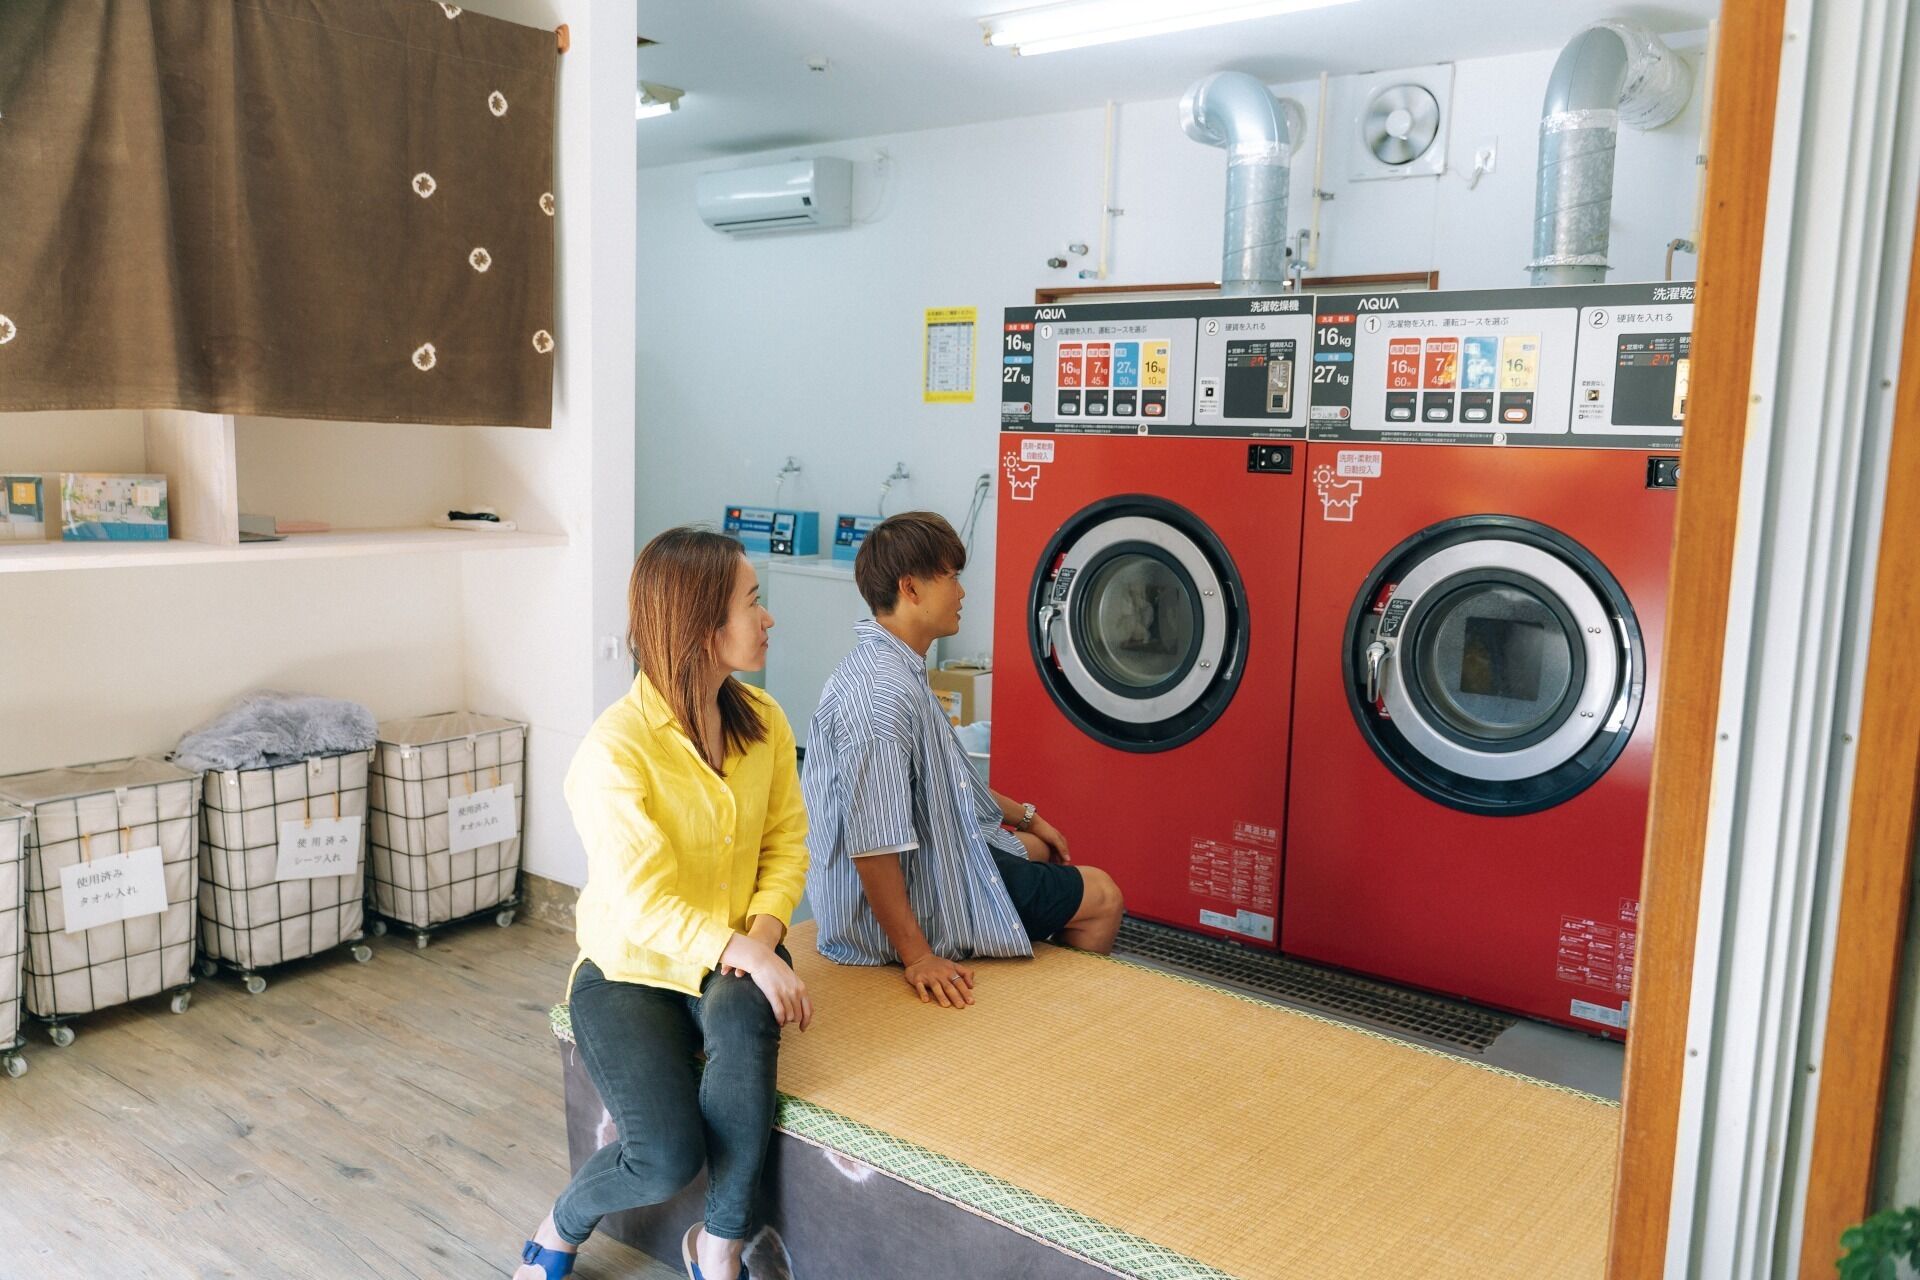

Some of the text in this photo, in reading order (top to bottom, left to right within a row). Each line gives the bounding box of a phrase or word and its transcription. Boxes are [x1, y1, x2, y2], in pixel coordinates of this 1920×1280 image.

[1653, 287, 1697, 300] 洗濯乾
[1250, 300, 1300, 312] 洗濯乾燥機
[1357, 298, 1400, 310] AQUA
[1035, 308, 1067, 320] AQUA
[1616, 313, 1673, 323] 硬貨を入れる
[1005, 334, 1032, 351] 16kg
[1317, 328, 1352, 347] 16kg
[1060, 361, 1081, 375] 16kg
[1093, 361, 1108, 375] 7kg
[1116, 361, 1137, 375] 27kg
[1391, 359, 1417, 375] 16kg
[1003, 367, 1031, 384] 27kg
[1313, 365, 1350, 385] 27kg
[76, 869, 123, 889] 使用済み
[80, 885, 139, 907] タオル入れ
